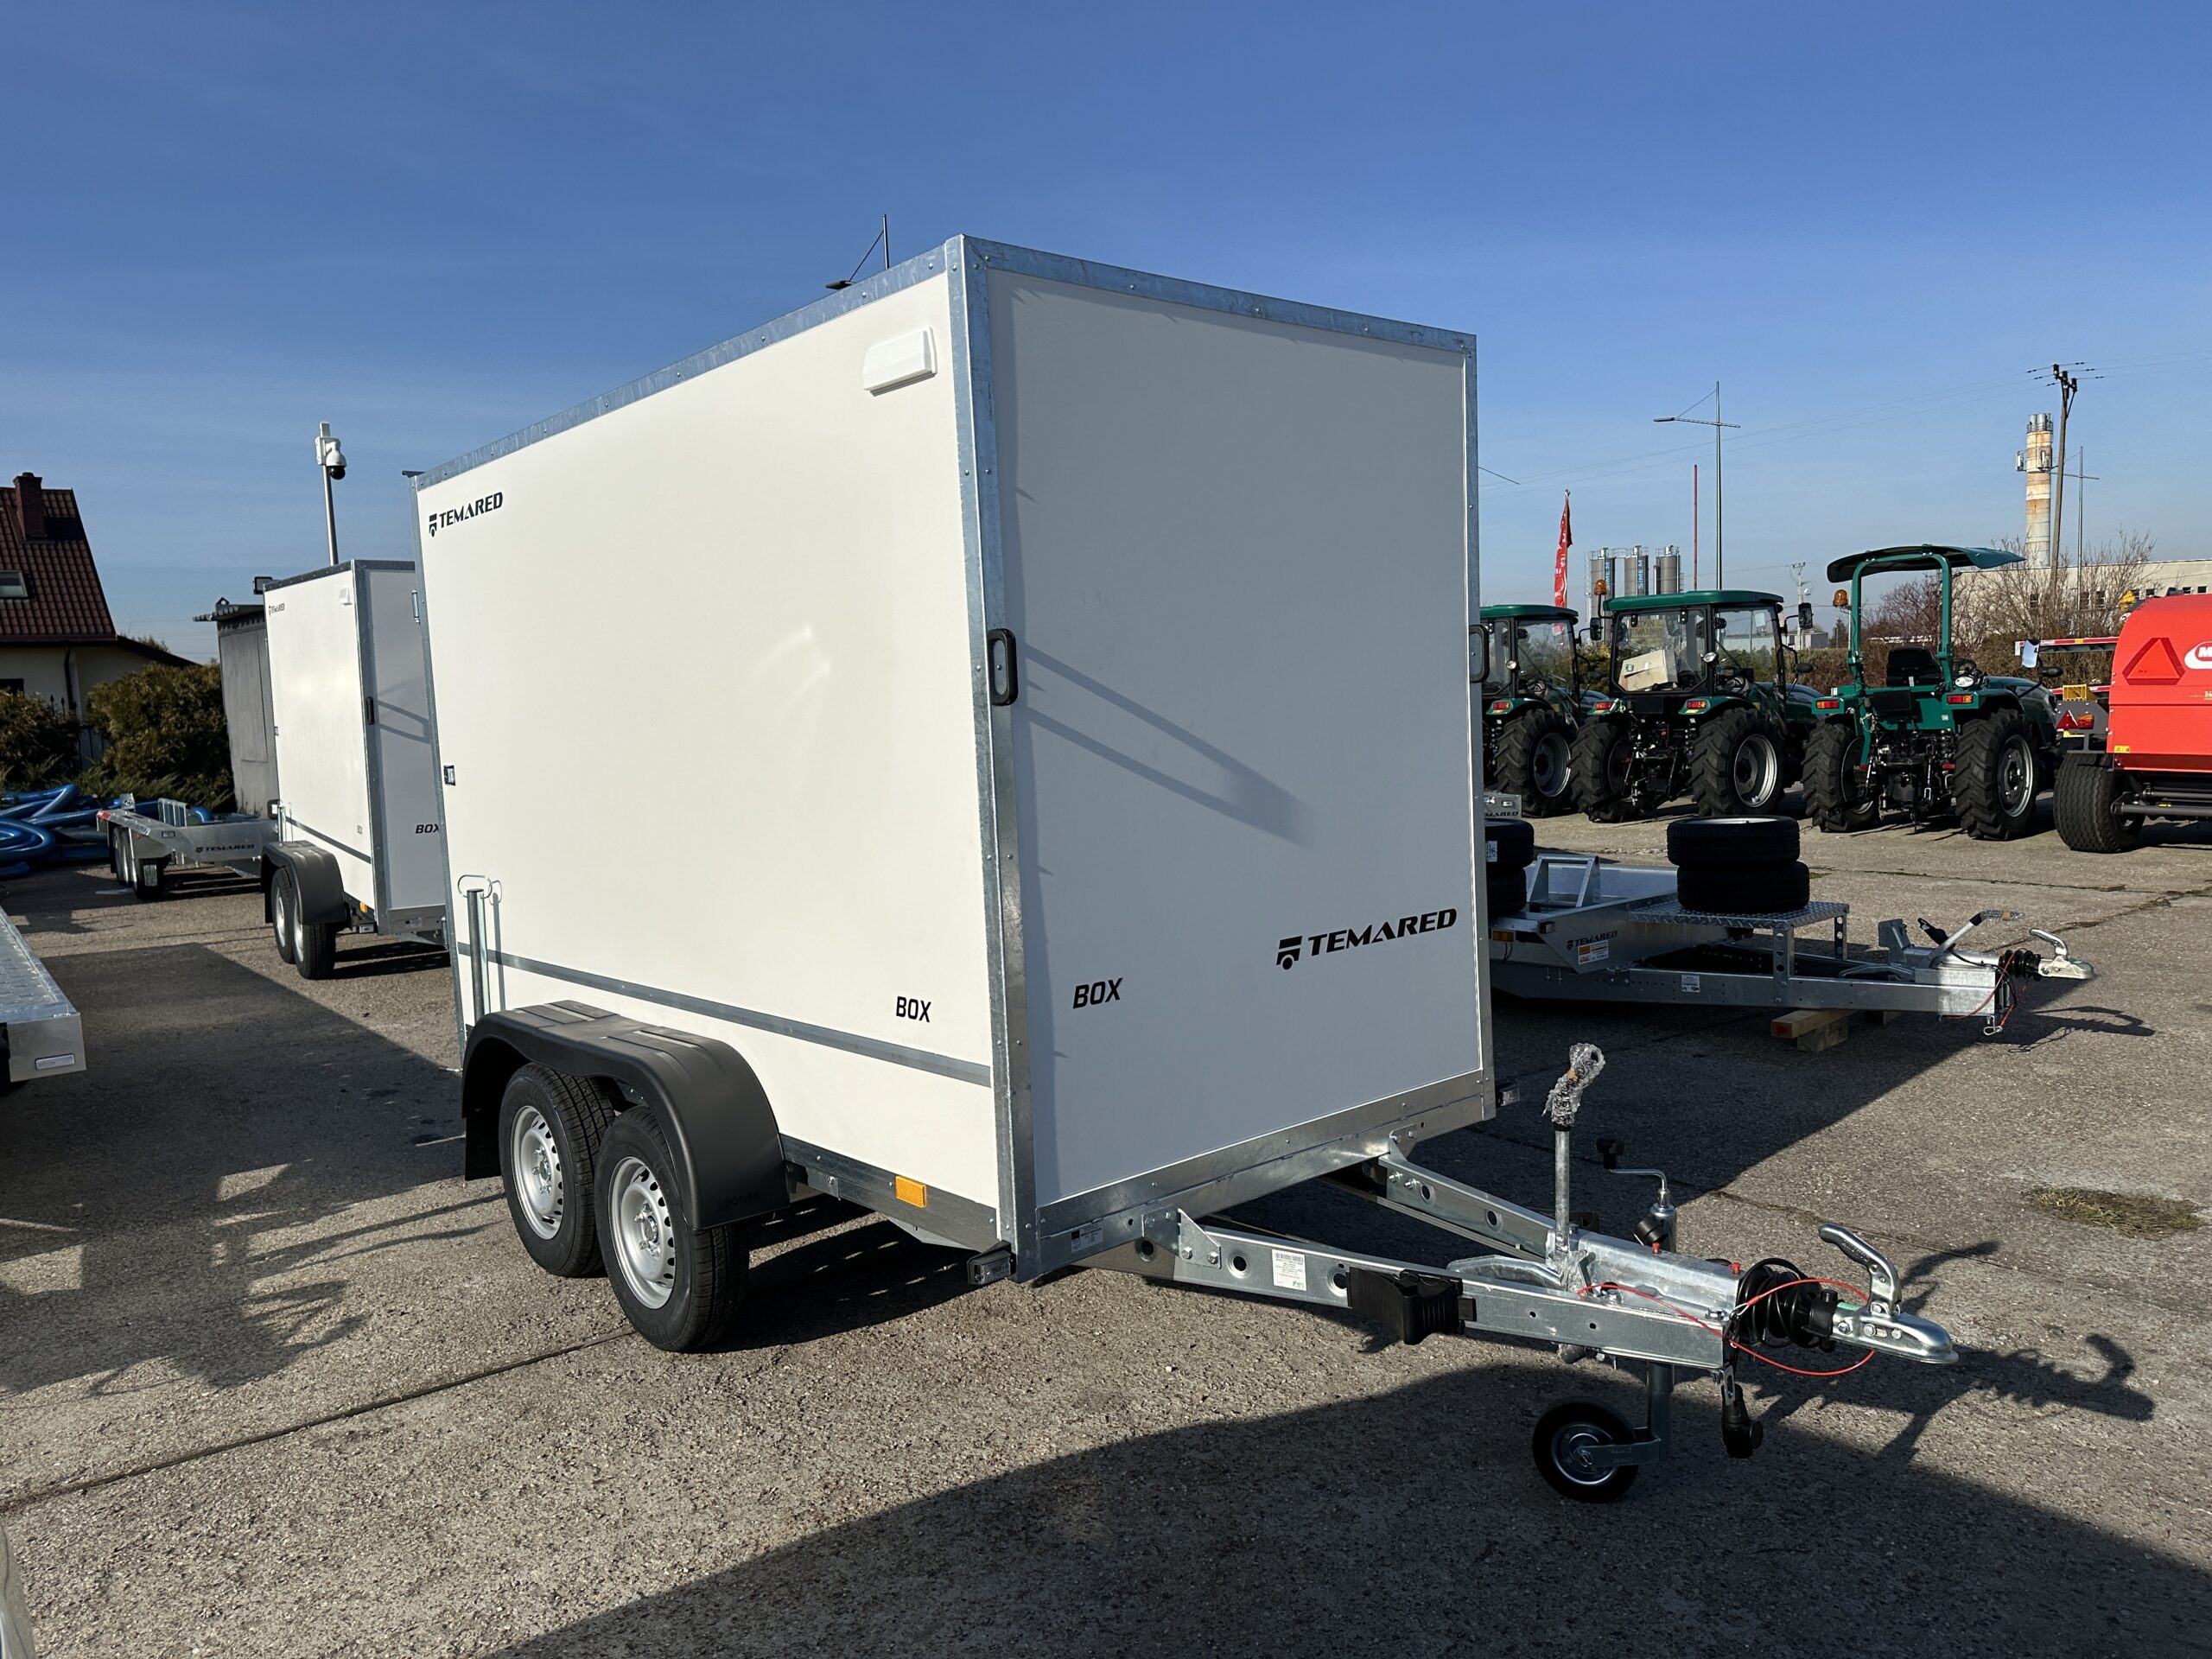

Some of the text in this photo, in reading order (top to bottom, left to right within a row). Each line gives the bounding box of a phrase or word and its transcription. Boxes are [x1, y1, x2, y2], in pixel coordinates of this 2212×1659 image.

[439, 491, 503, 529] TEMARED
[1308, 908, 1457, 957] TEMARED
[1574, 930, 1618, 947] TEMARED
[895, 995, 931, 1023] BOX
[1071, 977, 1123, 1009] BOX
